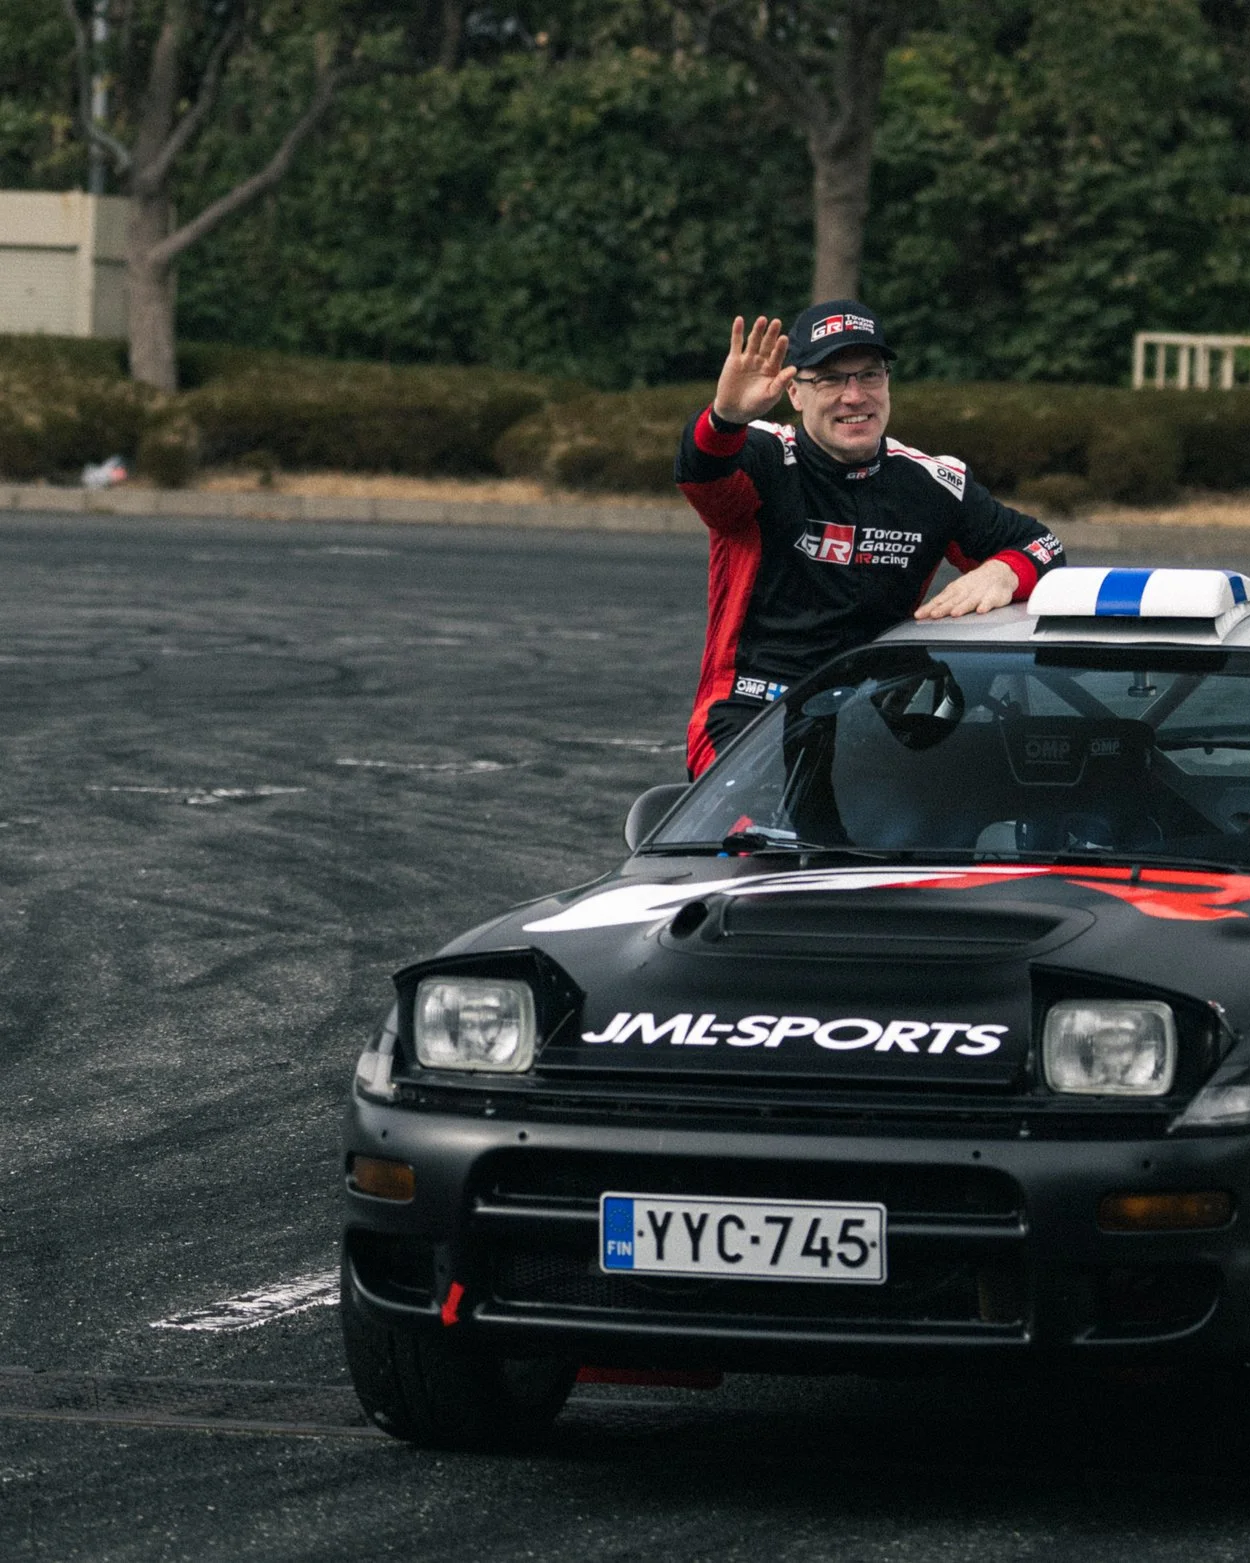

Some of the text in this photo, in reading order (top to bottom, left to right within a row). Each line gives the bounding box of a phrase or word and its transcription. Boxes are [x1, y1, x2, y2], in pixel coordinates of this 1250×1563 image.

[813, 321, 842, 339] GR
[937, 468, 963, 487] OMP
[862, 528, 922, 543] TOYOTA
[798, 531, 852, 563] GR
[858, 540, 916, 554] GAZOO
[857, 553, 909, 568] Racing
[736, 680, 766, 695] OMP
[1025, 740, 1070, 760] OMP
[1091, 740, 1120, 753] OMP
[581, 1012, 1009, 1056] JML-SPORTS
[607, 1240, 632, 1256] FIN
